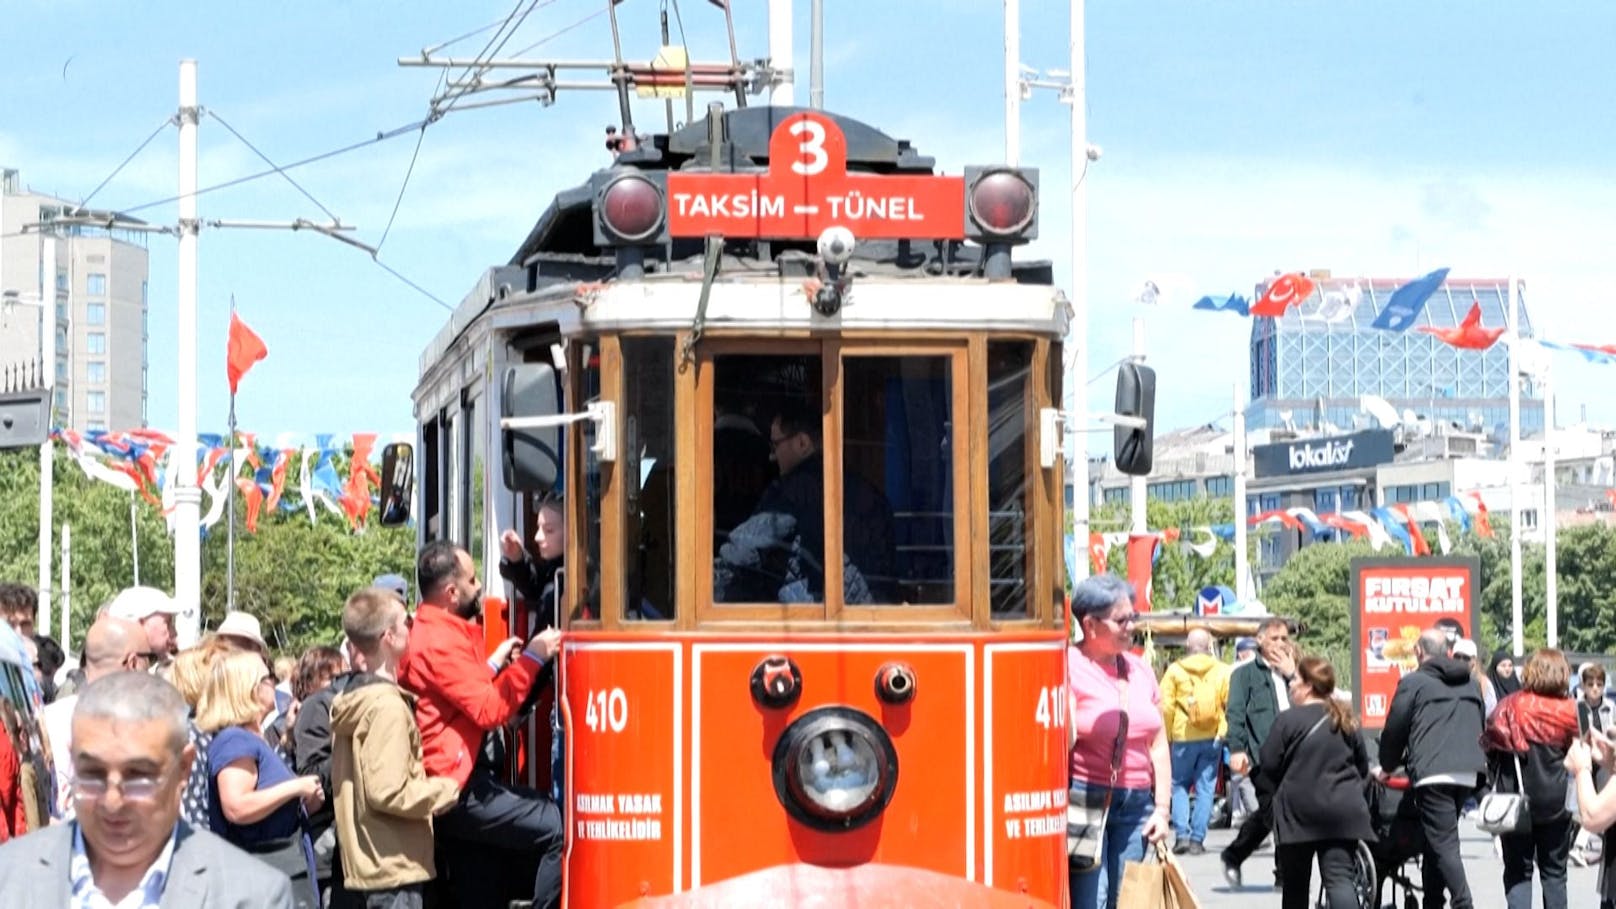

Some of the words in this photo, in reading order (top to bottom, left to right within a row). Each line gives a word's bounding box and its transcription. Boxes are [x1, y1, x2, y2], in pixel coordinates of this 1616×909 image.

[789, 119, 829, 176] 3
[673, 189, 785, 218] TAKSİM
[826, 191, 924, 220] TÜNEL
[1288, 439, 1354, 470] lokalist
[1365, 576, 1465, 598] FIRSAT
[585, 687, 628, 733] 410
[618, 794, 662, 814] YASAK
[1005, 818, 1021, 839] VE
